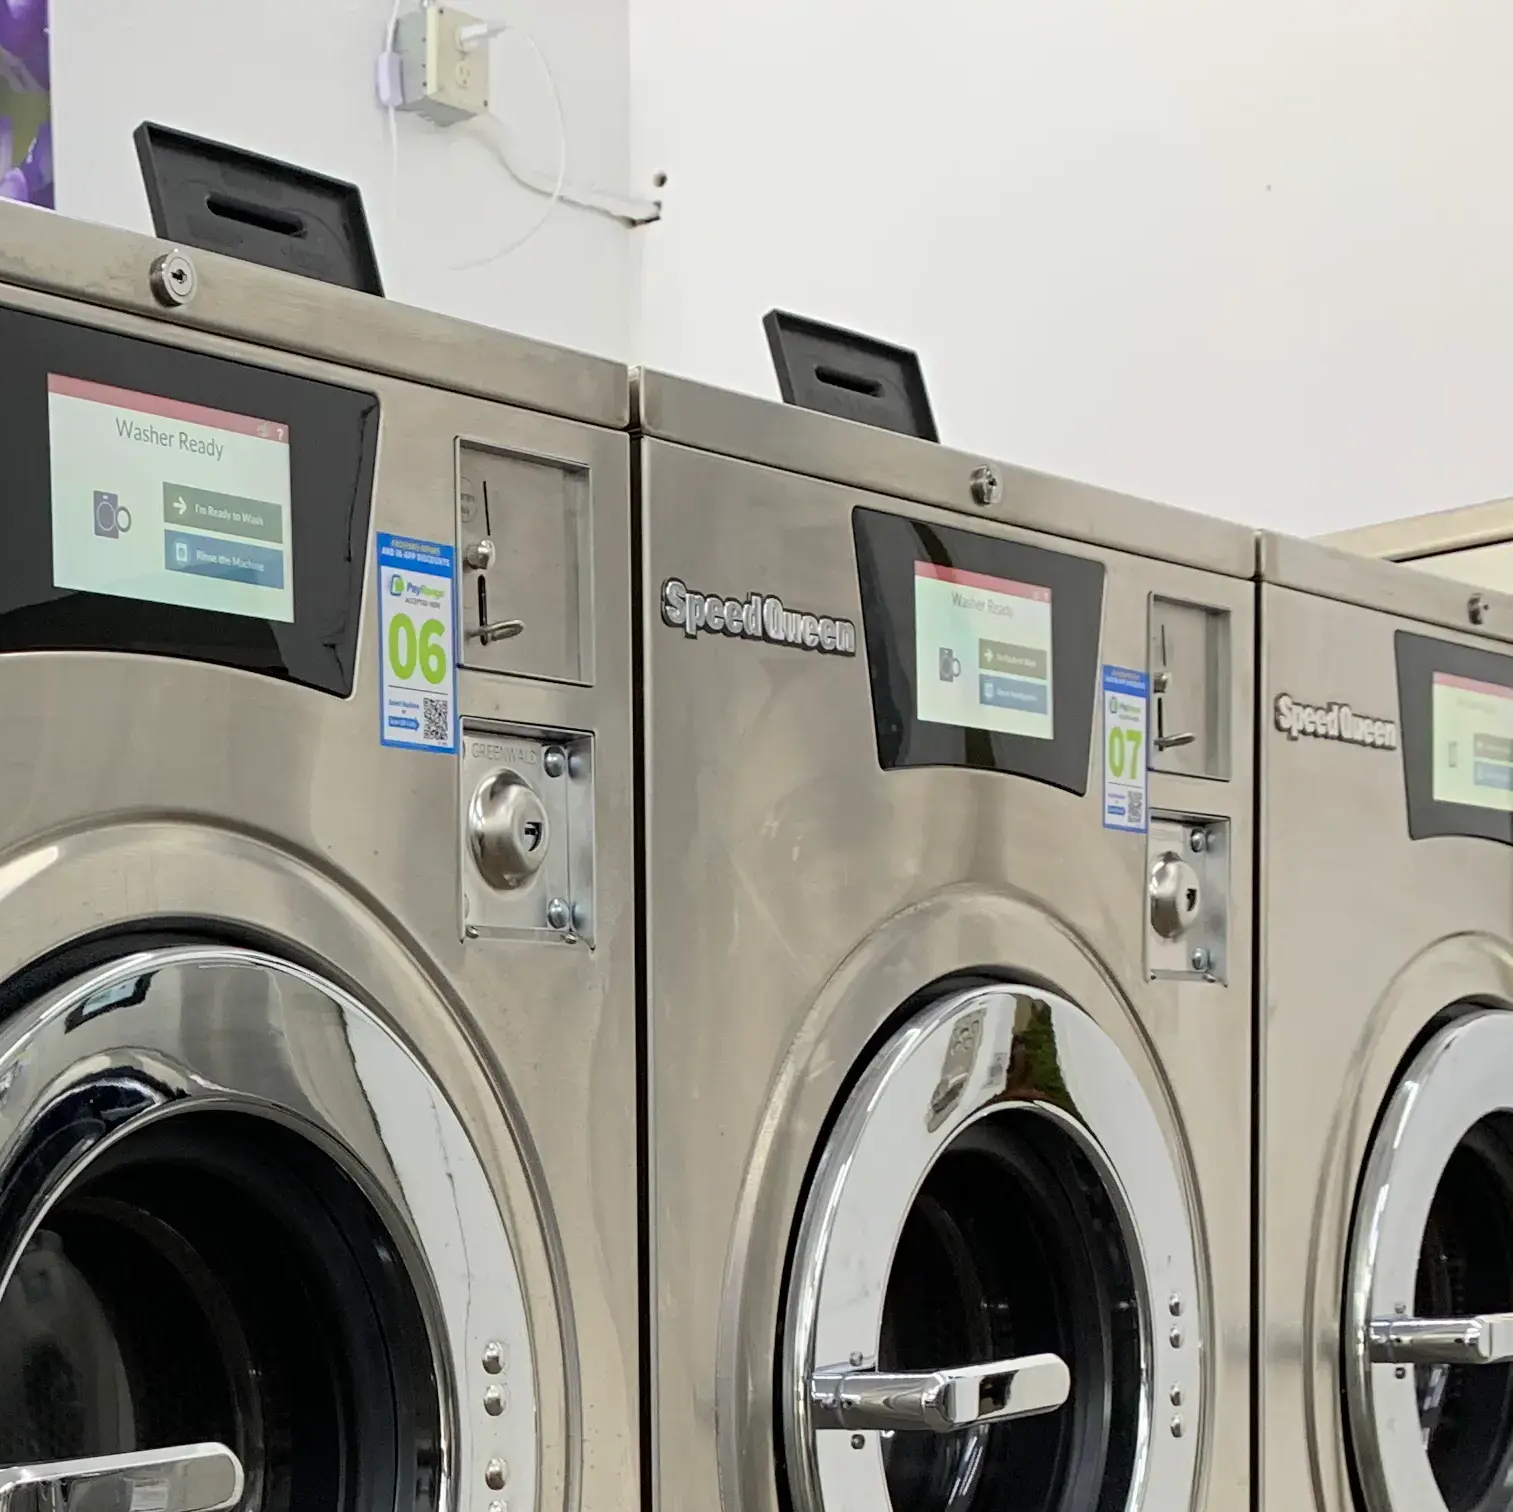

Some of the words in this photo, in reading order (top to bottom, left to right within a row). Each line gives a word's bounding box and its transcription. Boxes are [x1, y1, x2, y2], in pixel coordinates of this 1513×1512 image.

[115, 416, 175, 448] Washer
[178, 431, 224, 462] Ready
[207, 505, 232, 521] Ready
[232, 512, 241, 522] to
[241, 512, 264, 527] Wash
[196, 549, 218, 564] Rinse
[232, 556, 265, 572] Machine
[389, 612, 447, 685] 06
[471, 742, 538, 766] GREENWALD
[1108, 725, 1143, 780] 07
